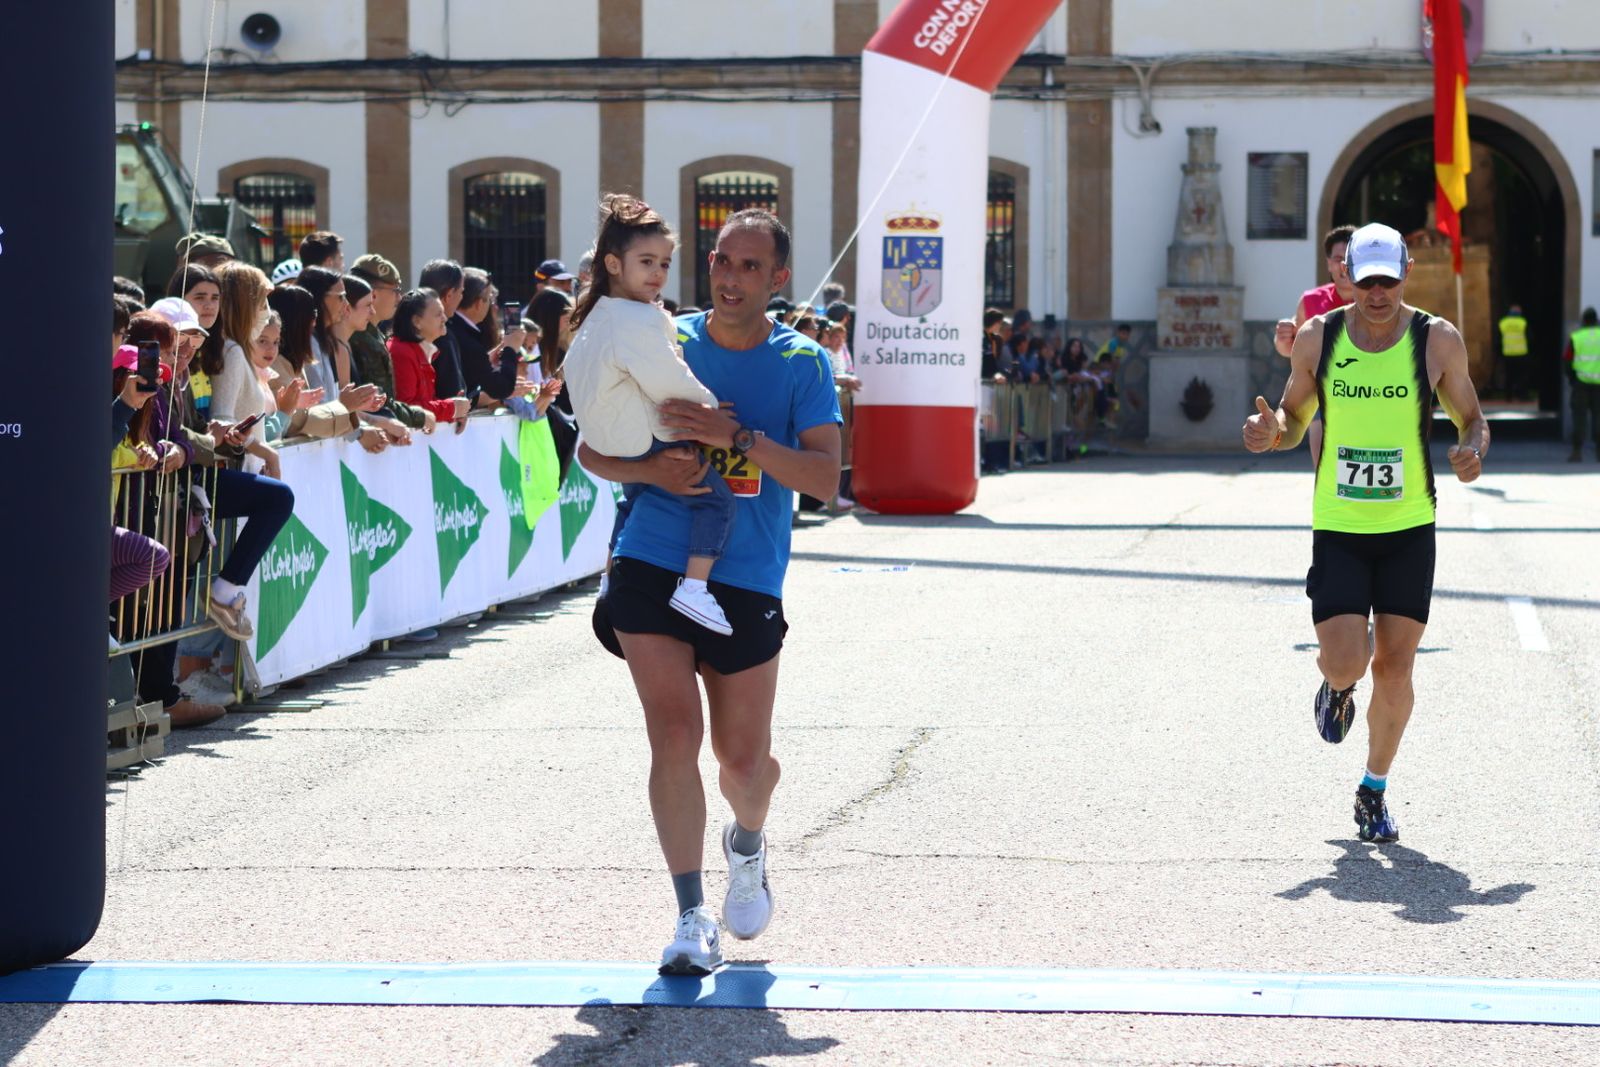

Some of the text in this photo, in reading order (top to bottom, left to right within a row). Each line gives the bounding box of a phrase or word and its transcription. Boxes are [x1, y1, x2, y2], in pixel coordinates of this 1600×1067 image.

[914, 9, 949, 48] CON
[867, 322, 959, 342] Diputación
[860, 347, 966, 366] de Salamanca
[1346, 462, 1394, 487] 713
